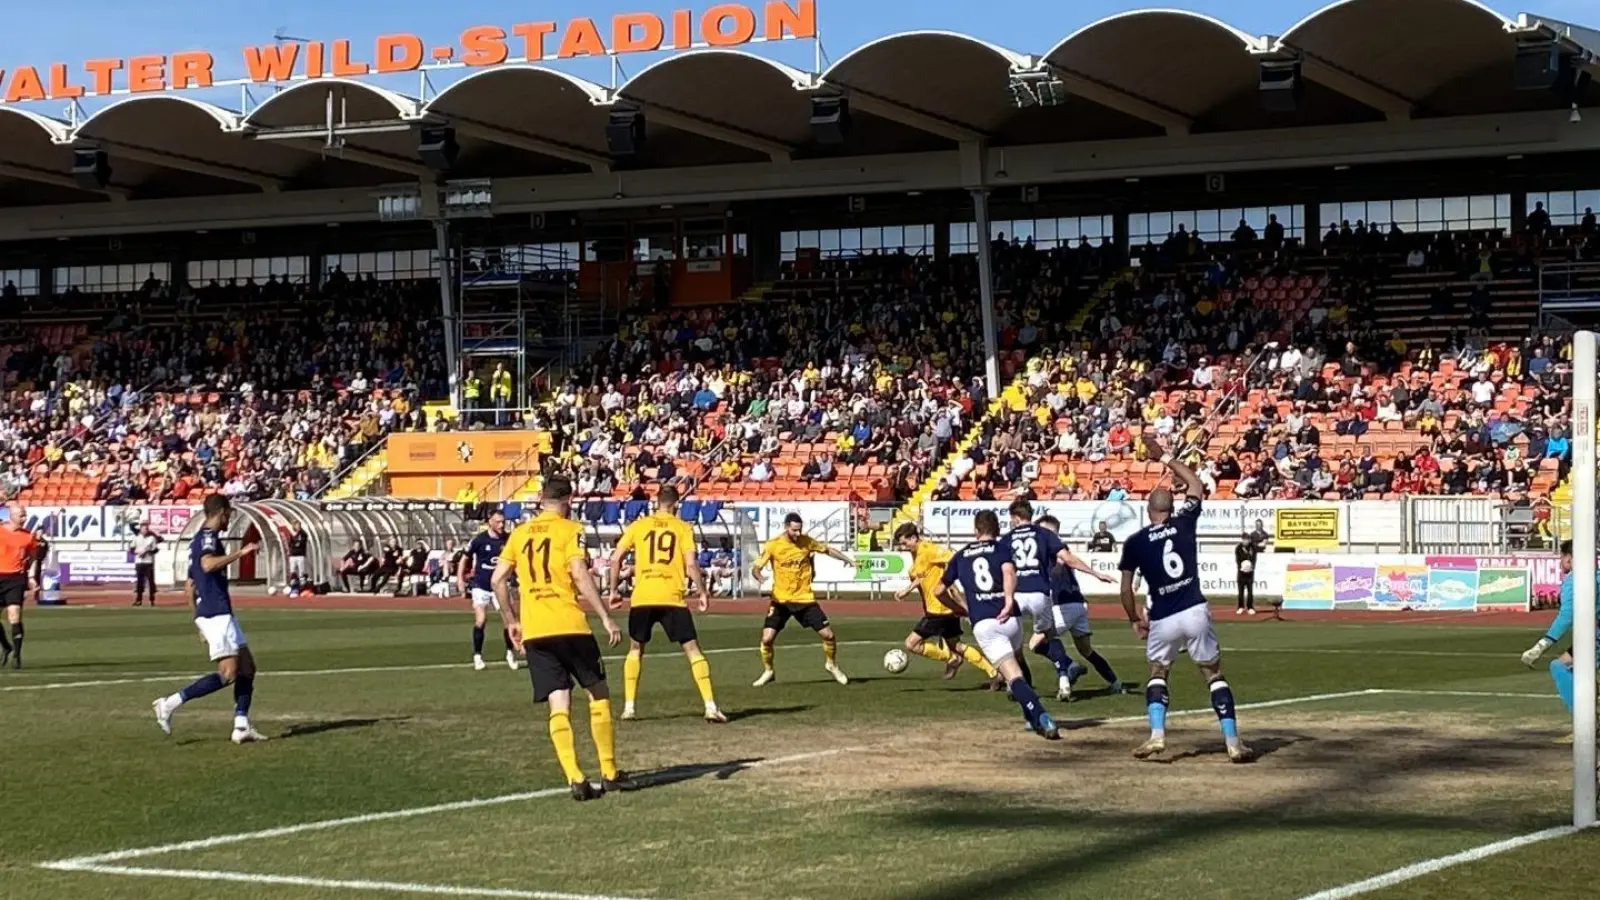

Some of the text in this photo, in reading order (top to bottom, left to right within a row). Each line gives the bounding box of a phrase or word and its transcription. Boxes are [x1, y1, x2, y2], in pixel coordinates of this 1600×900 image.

[0, 0, 818, 102] ALTER WILD-STADION
[521, 537, 551, 584] 11
[643, 530, 676, 565] 19
[1011, 537, 1040, 568] 32
[1162, 539, 1184, 578] 6
[972, 556, 994, 591] 8
